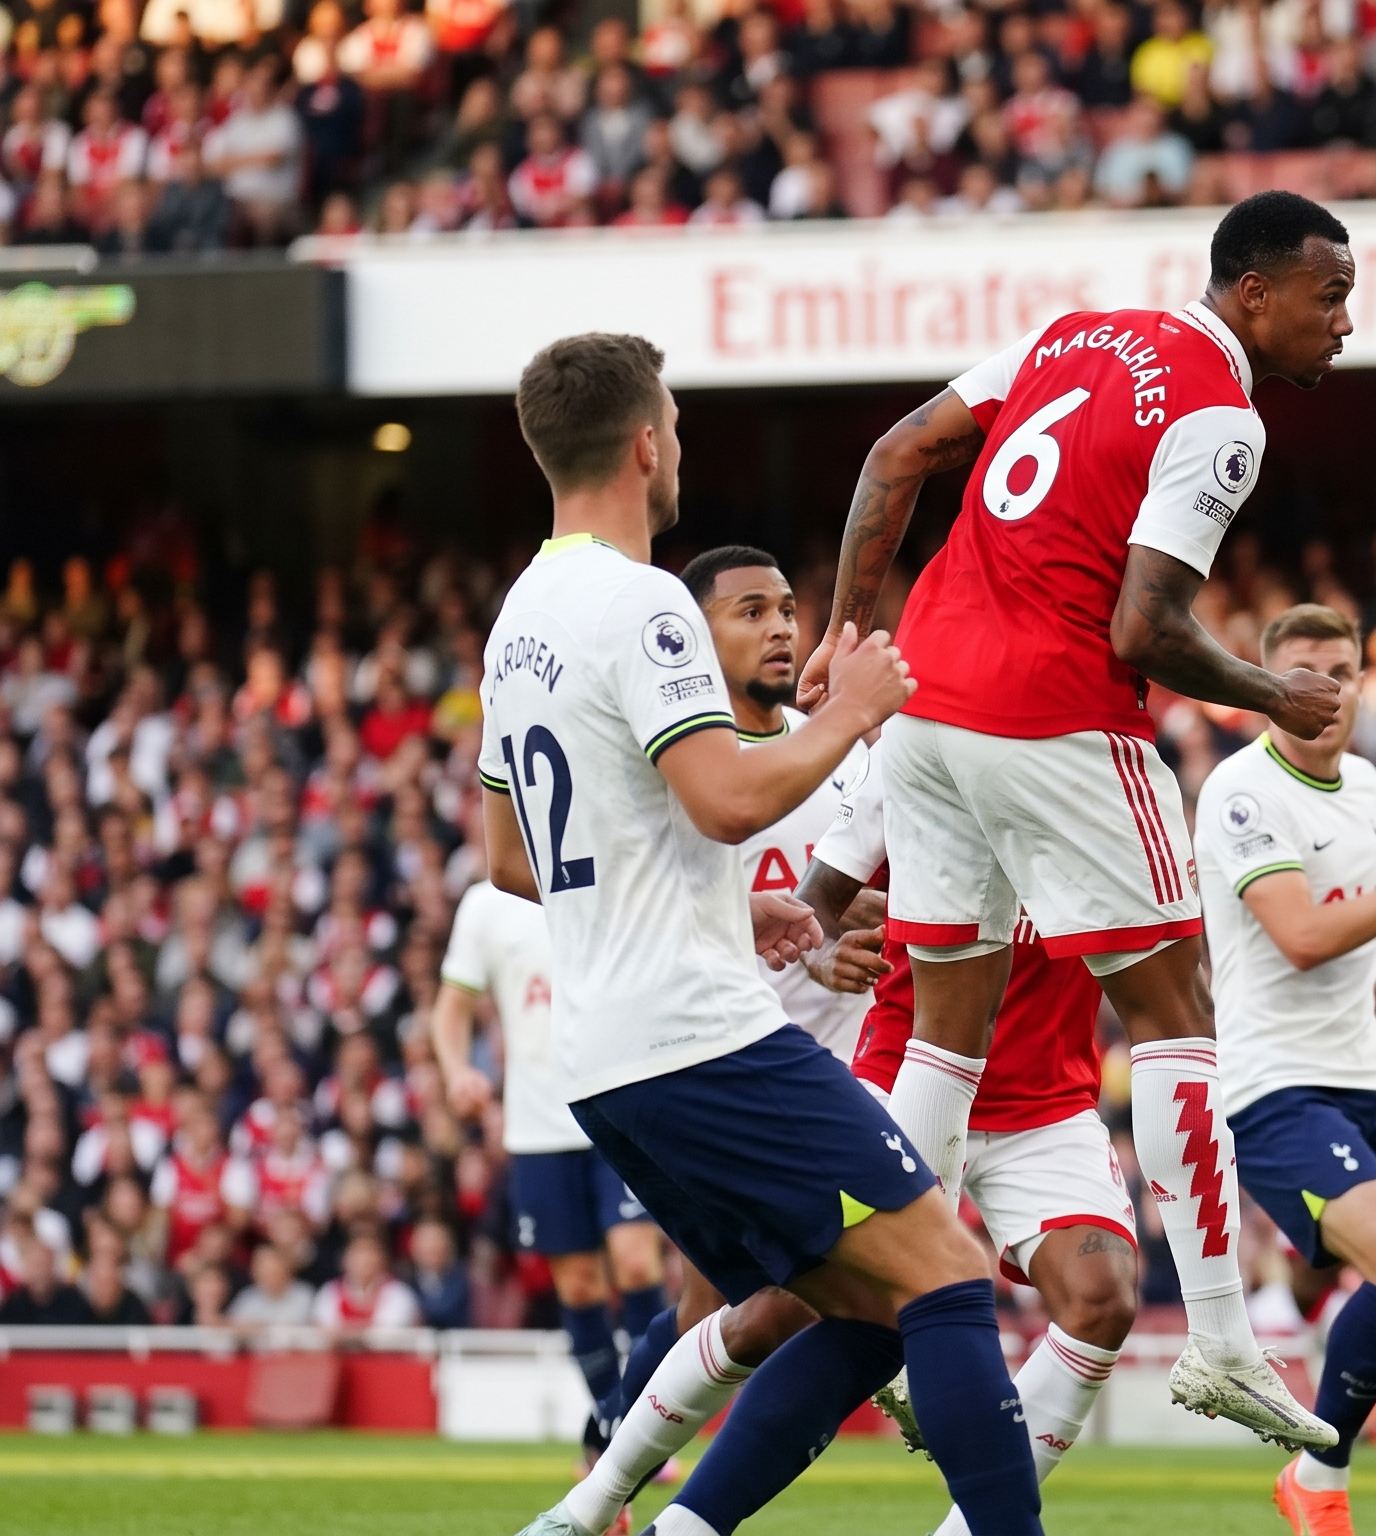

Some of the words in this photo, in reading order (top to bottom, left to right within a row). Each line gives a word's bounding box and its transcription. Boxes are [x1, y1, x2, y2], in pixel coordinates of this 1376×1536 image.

[982, 387, 1091, 521] 6
[489, 636, 563, 706] ARDREN
[501, 725, 595, 893] 12
